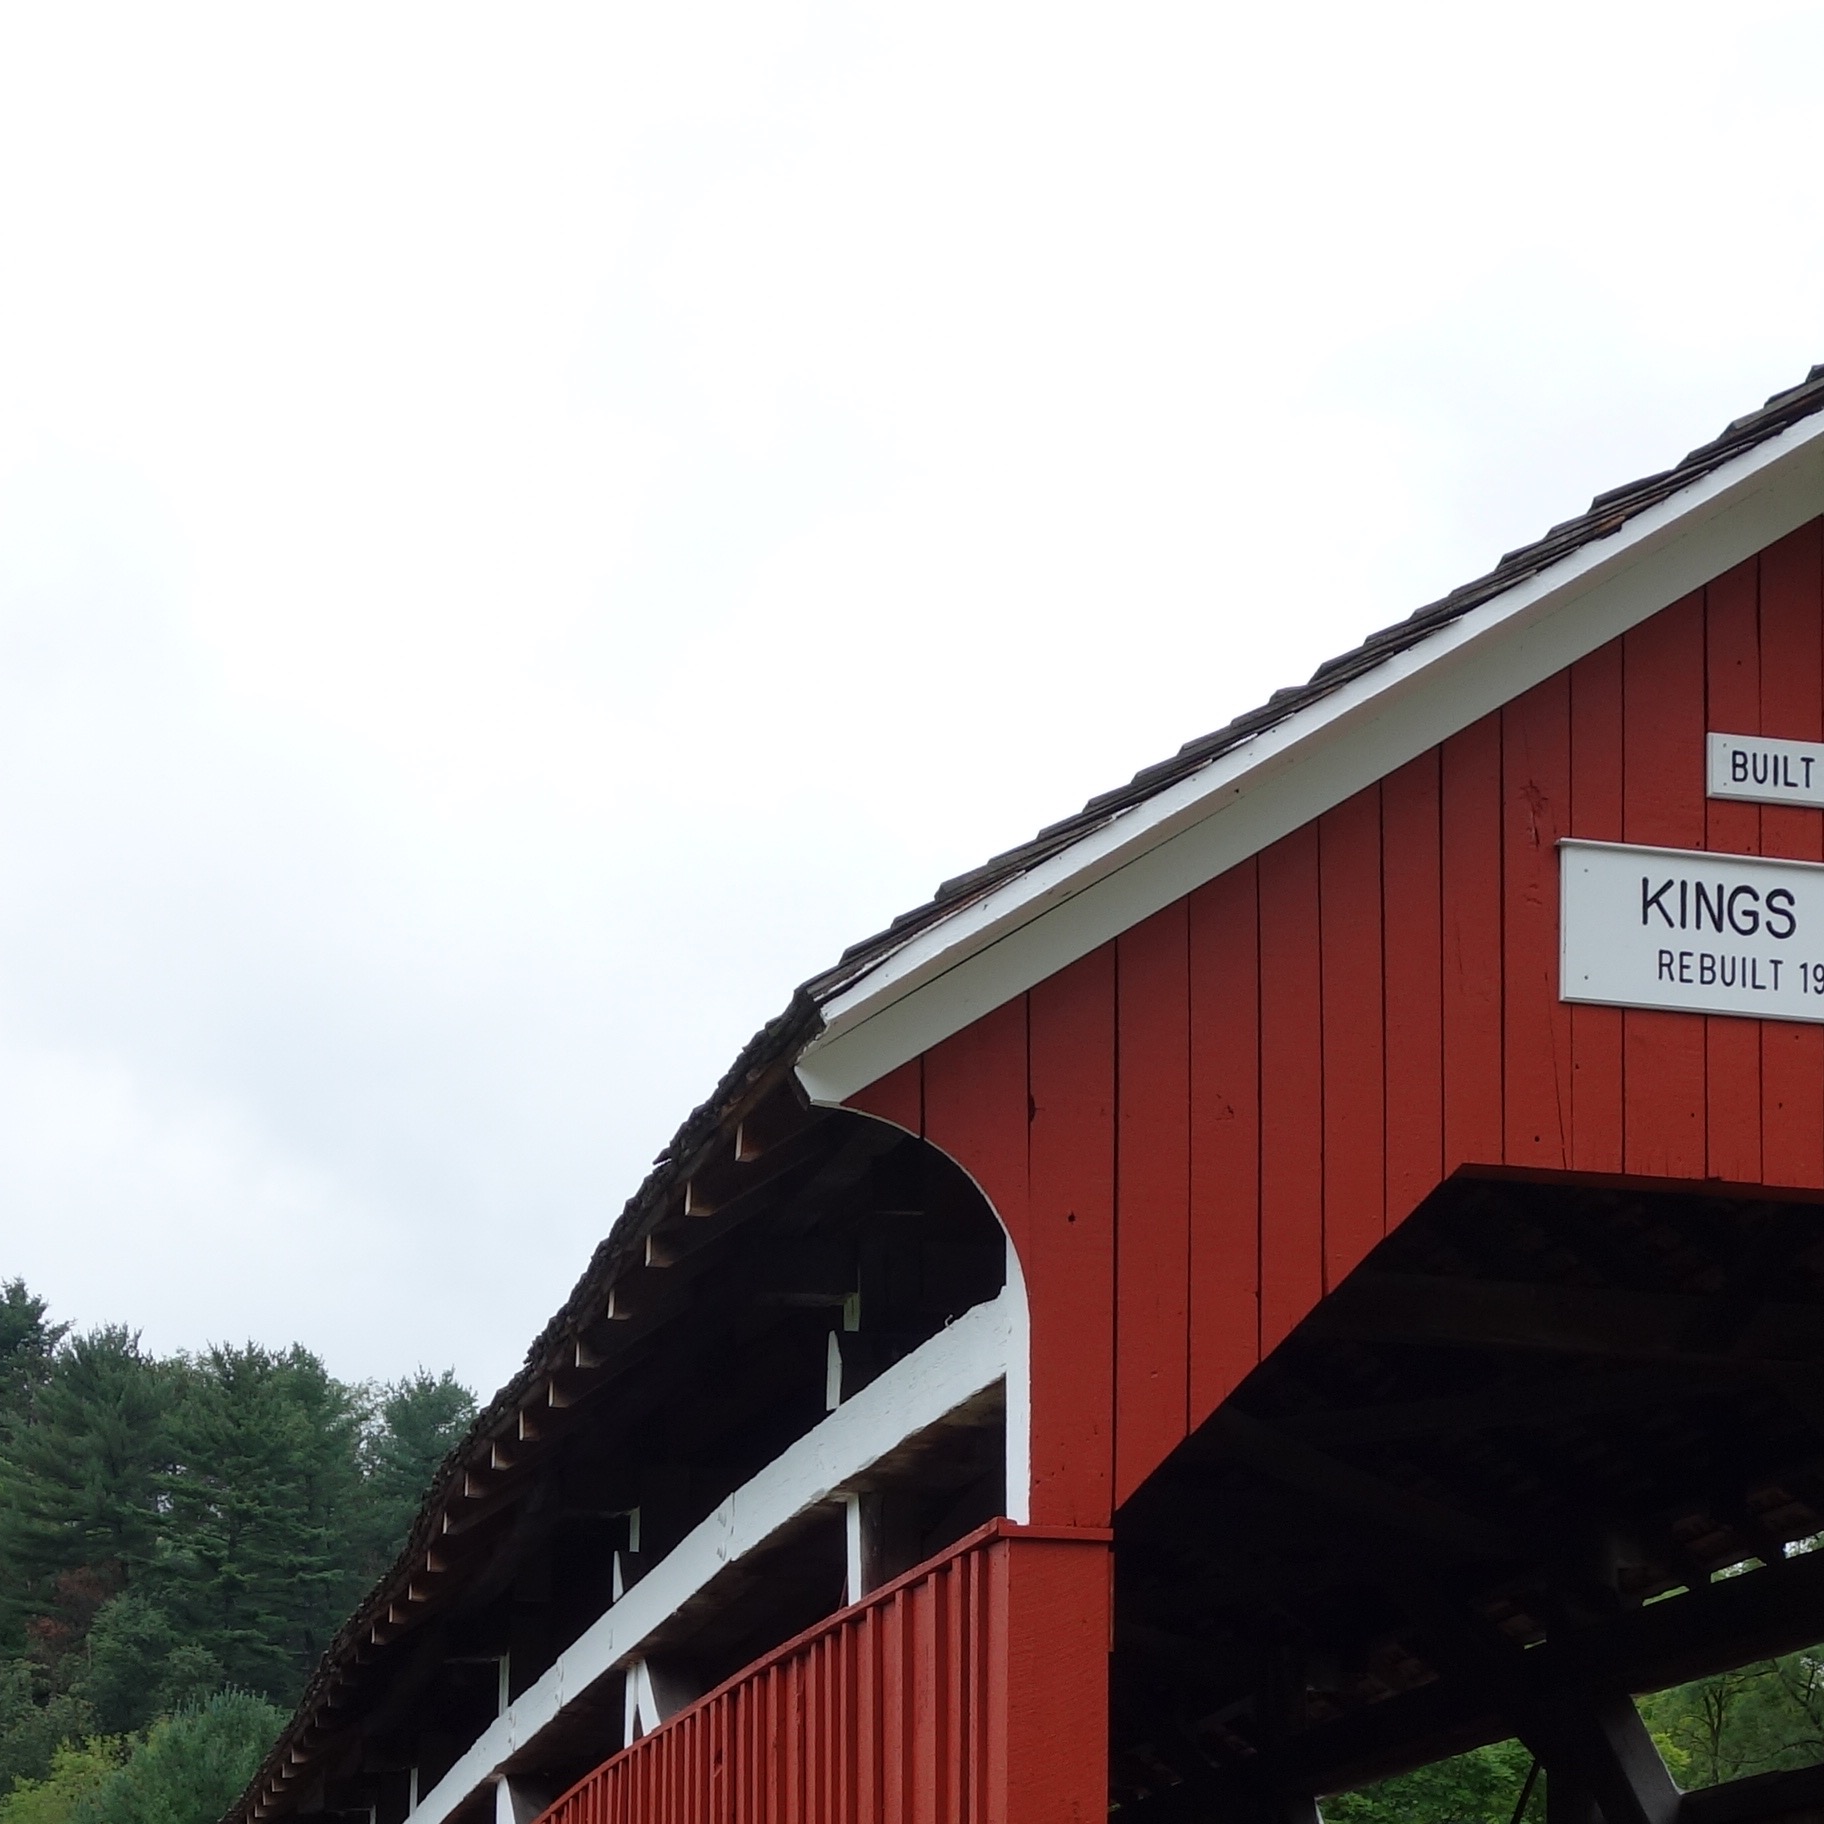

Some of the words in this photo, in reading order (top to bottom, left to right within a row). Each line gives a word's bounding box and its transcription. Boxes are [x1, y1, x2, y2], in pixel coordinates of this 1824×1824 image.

[1731, 749, 1816, 789] BUILT
[1641, 876, 1797, 940] KINGS
[1658, 949, 1784, 991] REBUILT
